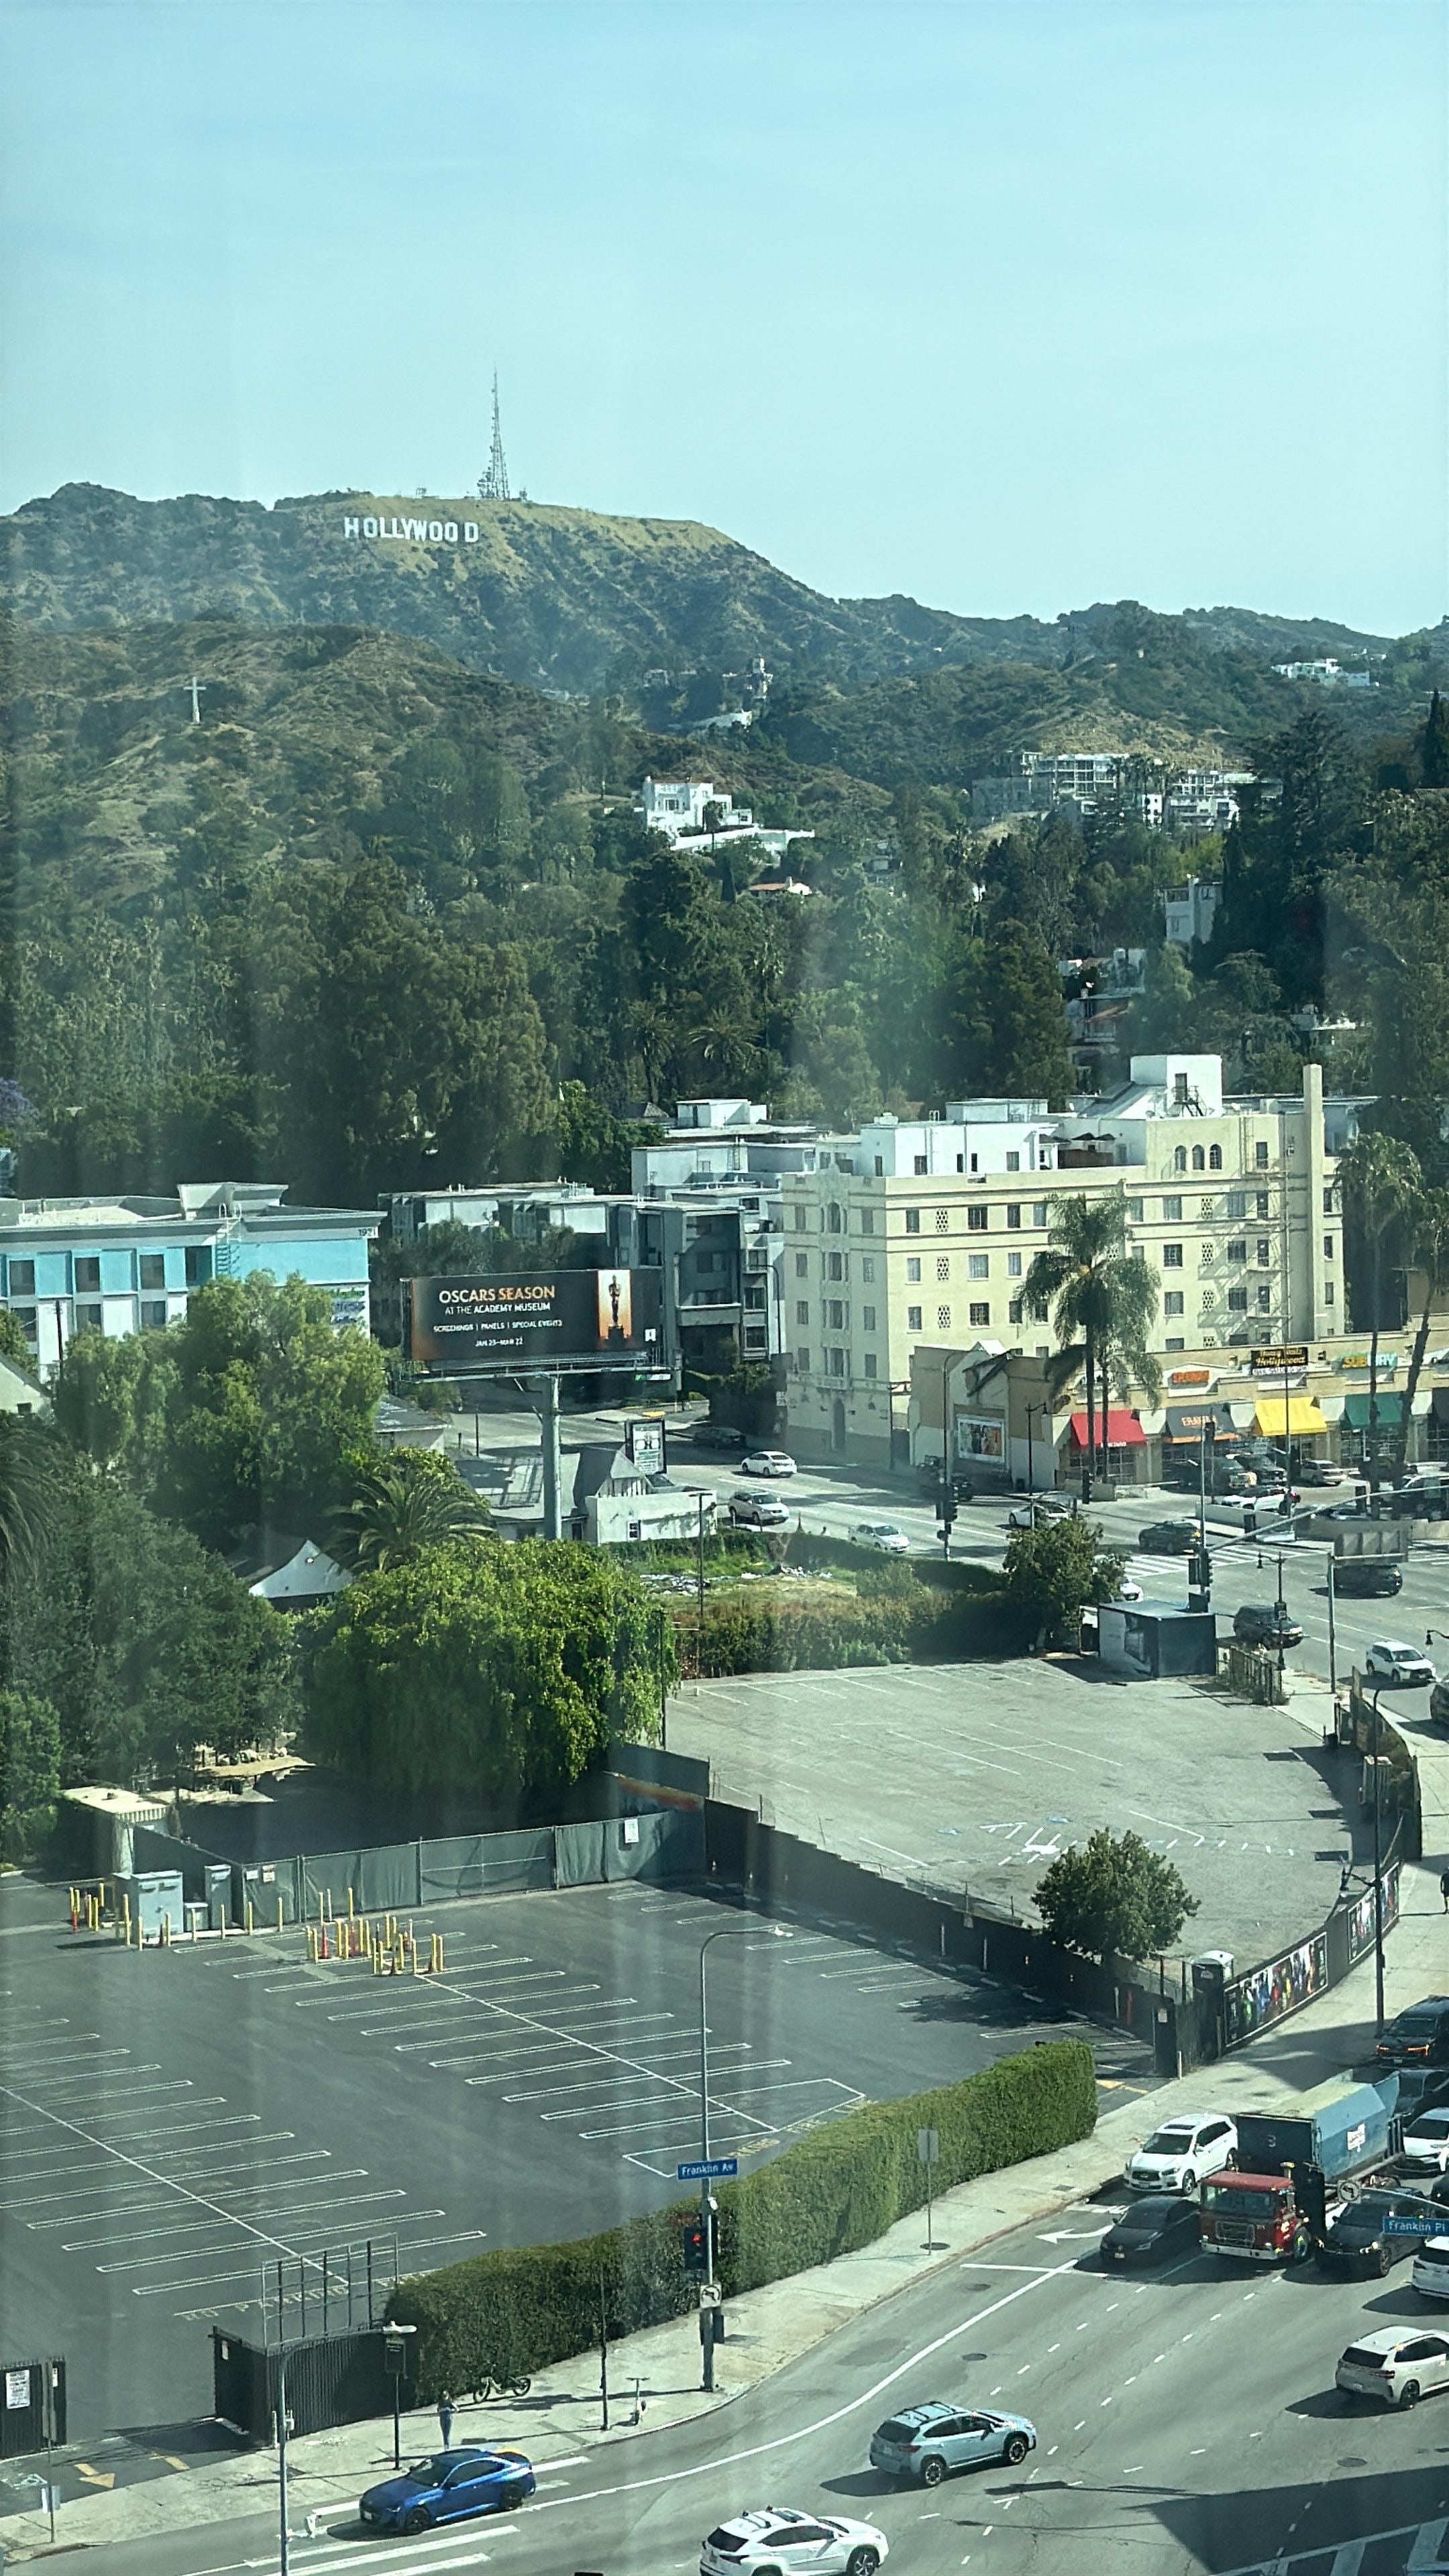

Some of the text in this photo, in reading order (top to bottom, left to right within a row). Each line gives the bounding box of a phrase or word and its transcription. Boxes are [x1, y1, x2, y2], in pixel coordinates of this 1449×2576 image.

[344, 517, 479, 543] HOLLYWOOD
[439, 1285, 555, 1303] OSCARS SEASON
[445, 1302, 551, 1315] AT THE ACADEMY MUSEUM
[481, 1322, 505, 1330] PANELS
[512, 1321, 537, 1329] SPECIAL
[682, 2163, 718, 2176] Franklin
[1389, 2220, 1445, 2233] Franklin Pl
